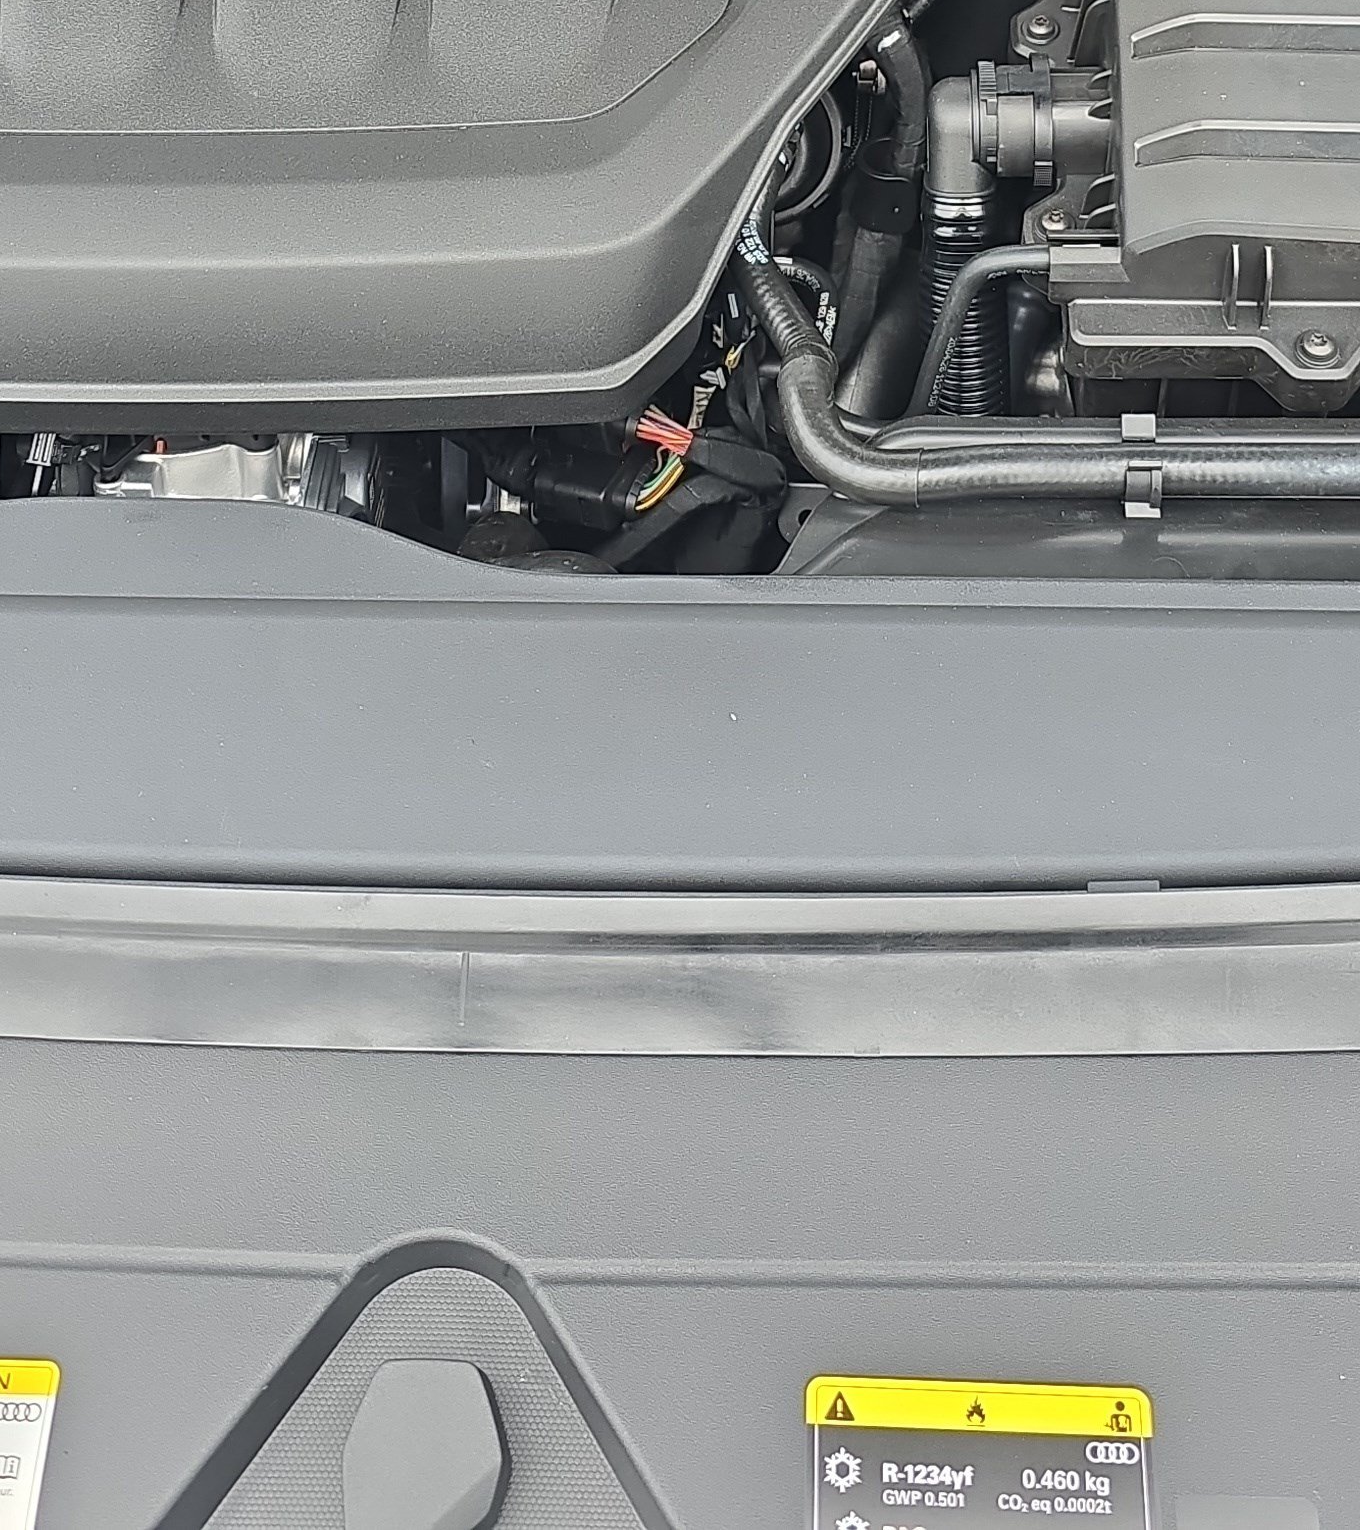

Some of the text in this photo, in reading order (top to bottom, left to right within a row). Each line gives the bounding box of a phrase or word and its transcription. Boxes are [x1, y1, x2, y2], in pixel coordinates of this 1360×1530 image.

[882, 1462, 976, 1491] R-1234yf
[1022, 1468, 1111, 1497] 0.460 kg
[882, 1489, 966, 1508] GWP 0.501
[1031, 1499, 1053, 1515] eq
[1053, 1496, 1113, 1515] 0.0002t
